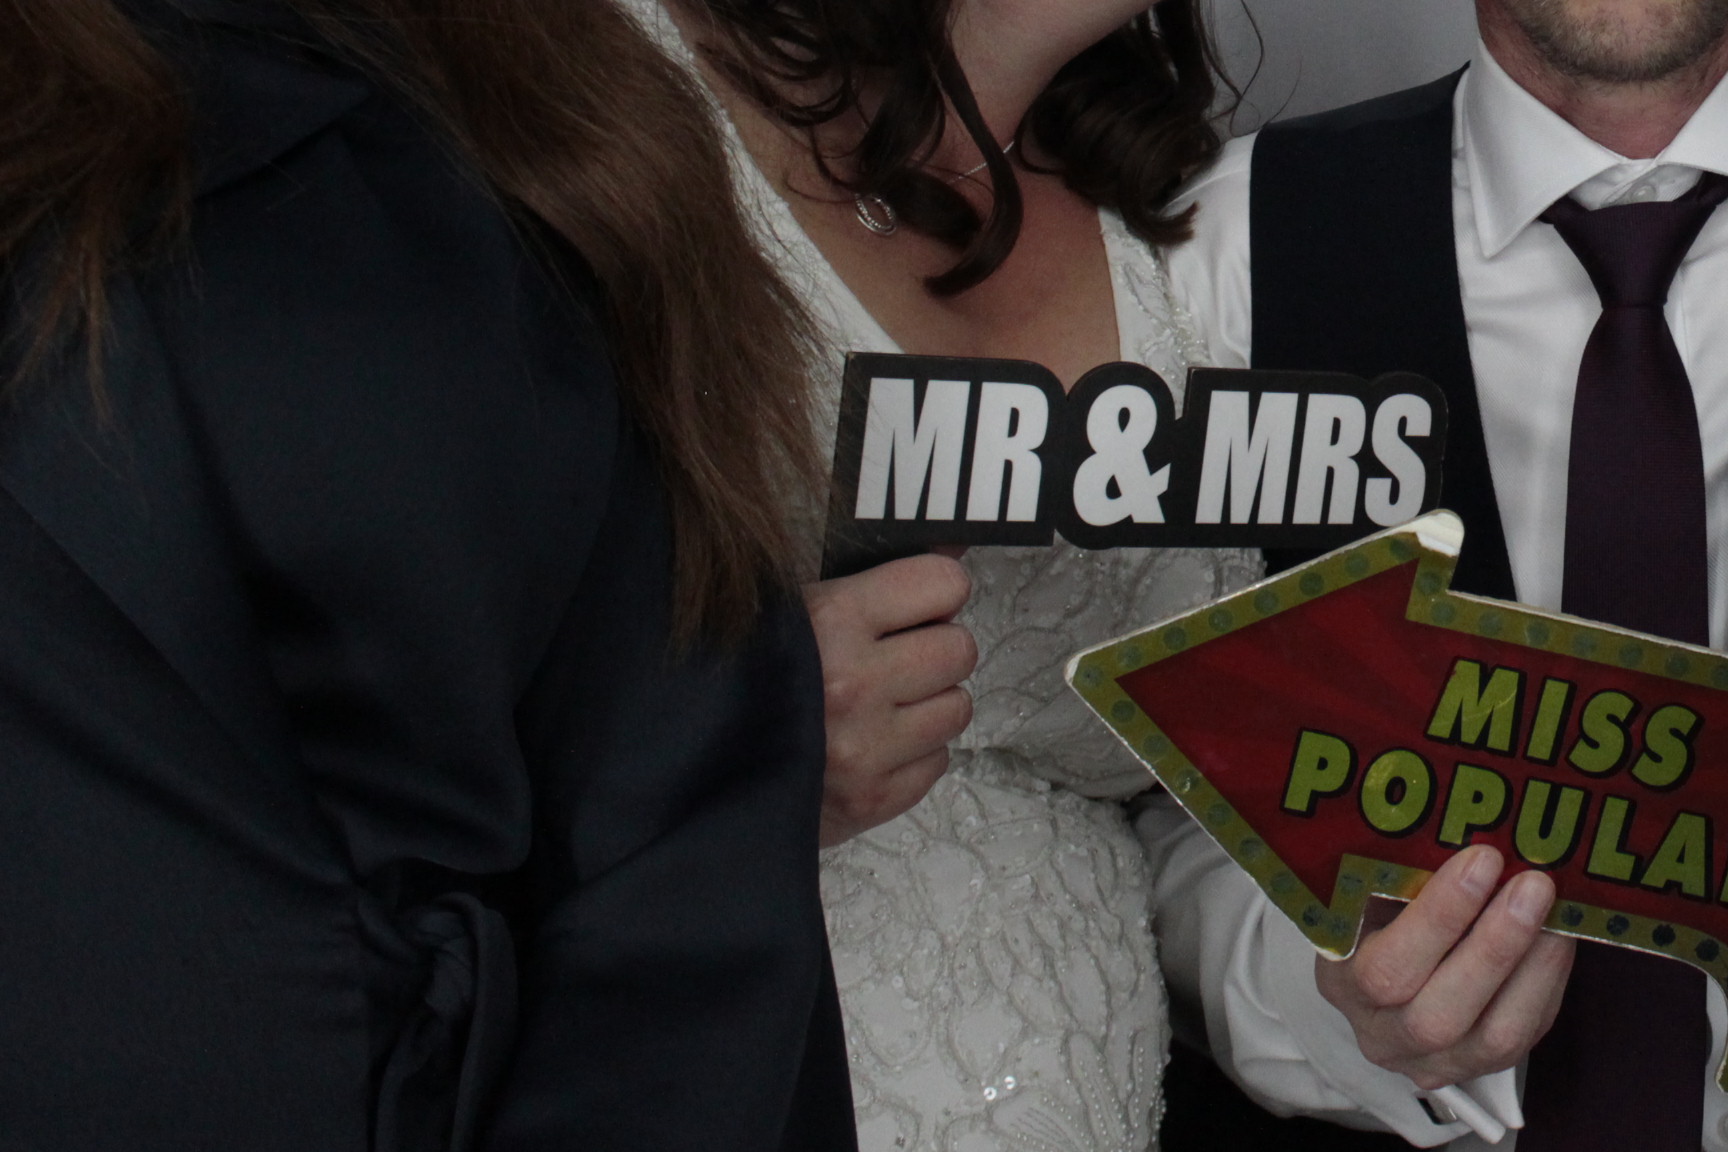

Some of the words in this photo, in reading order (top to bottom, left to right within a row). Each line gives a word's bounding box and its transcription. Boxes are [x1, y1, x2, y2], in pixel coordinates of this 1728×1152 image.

[854, 377, 1049, 522] MR
[1072, 384, 1171, 526] &
[1195, 390, 1432, 527] MRS
[1426, 658, 1701, 788] MISS
